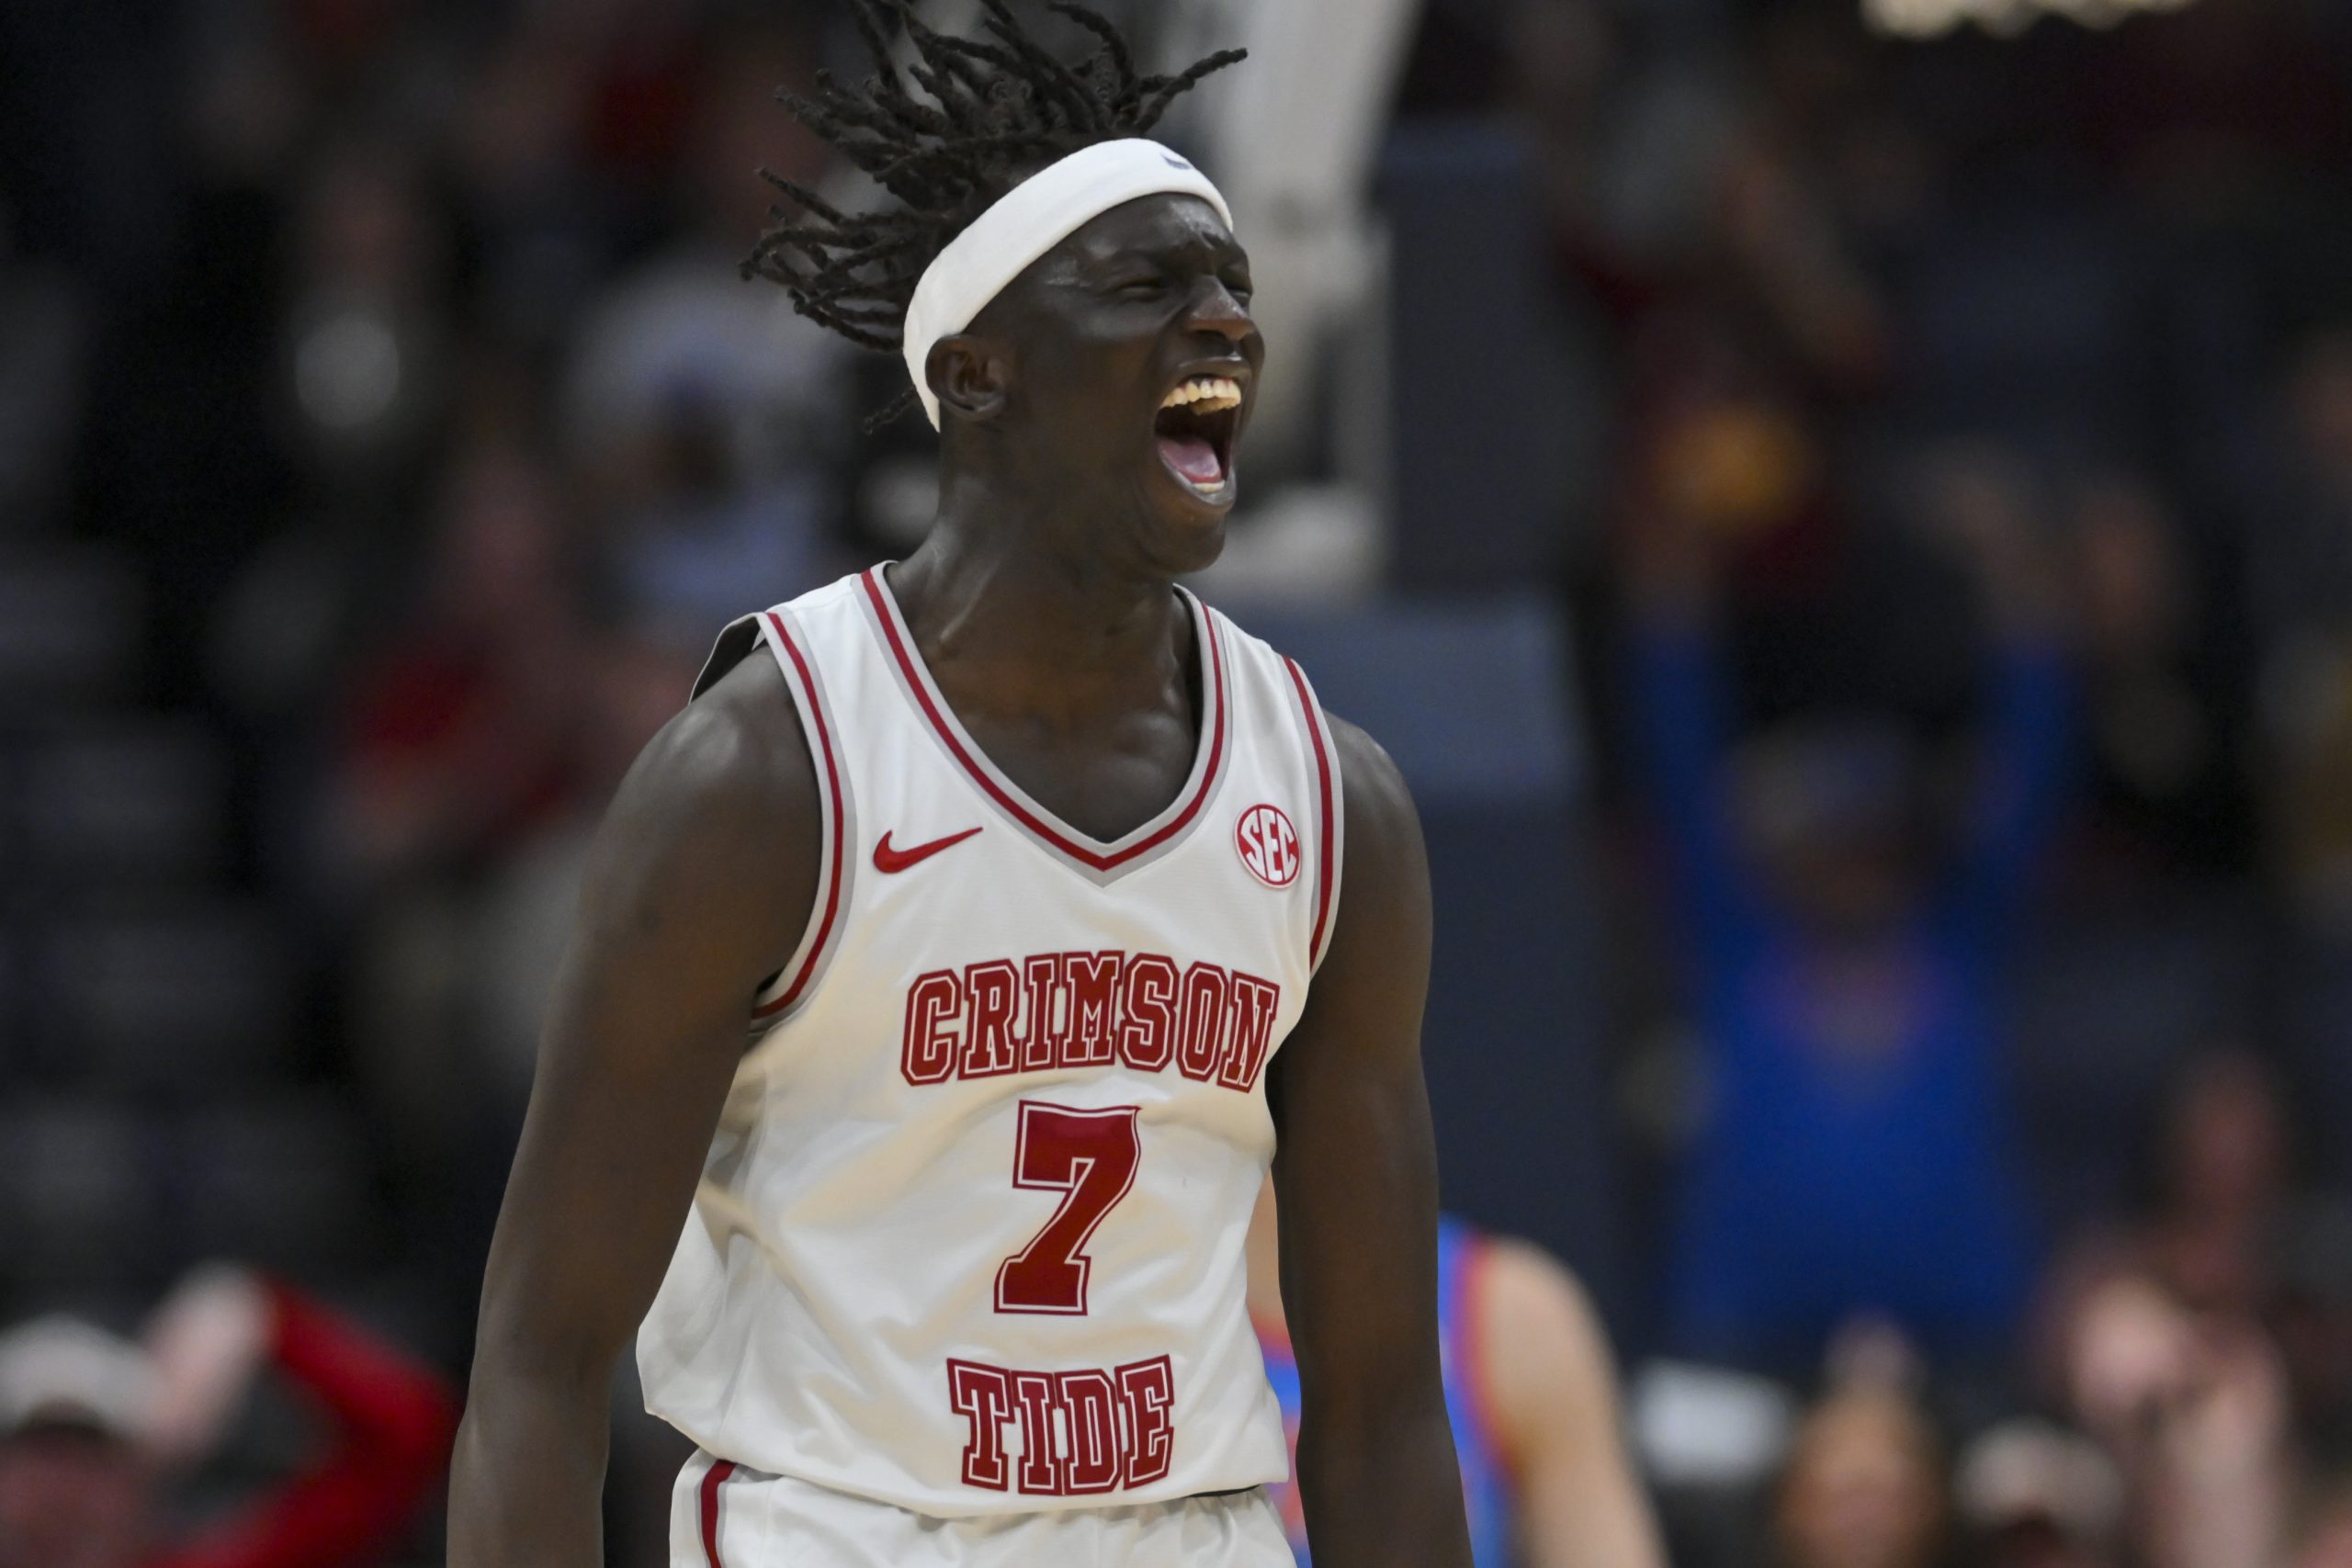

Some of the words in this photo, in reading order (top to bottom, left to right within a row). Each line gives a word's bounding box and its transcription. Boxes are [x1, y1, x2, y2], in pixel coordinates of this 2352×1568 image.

[1239, 807, 1297, 882] SEC
[900, 950, 1280, 1093] CRIMSON
[993, 1099, 1142, 1315] 7
[946, 1354, 1174, 1495] TIDE
